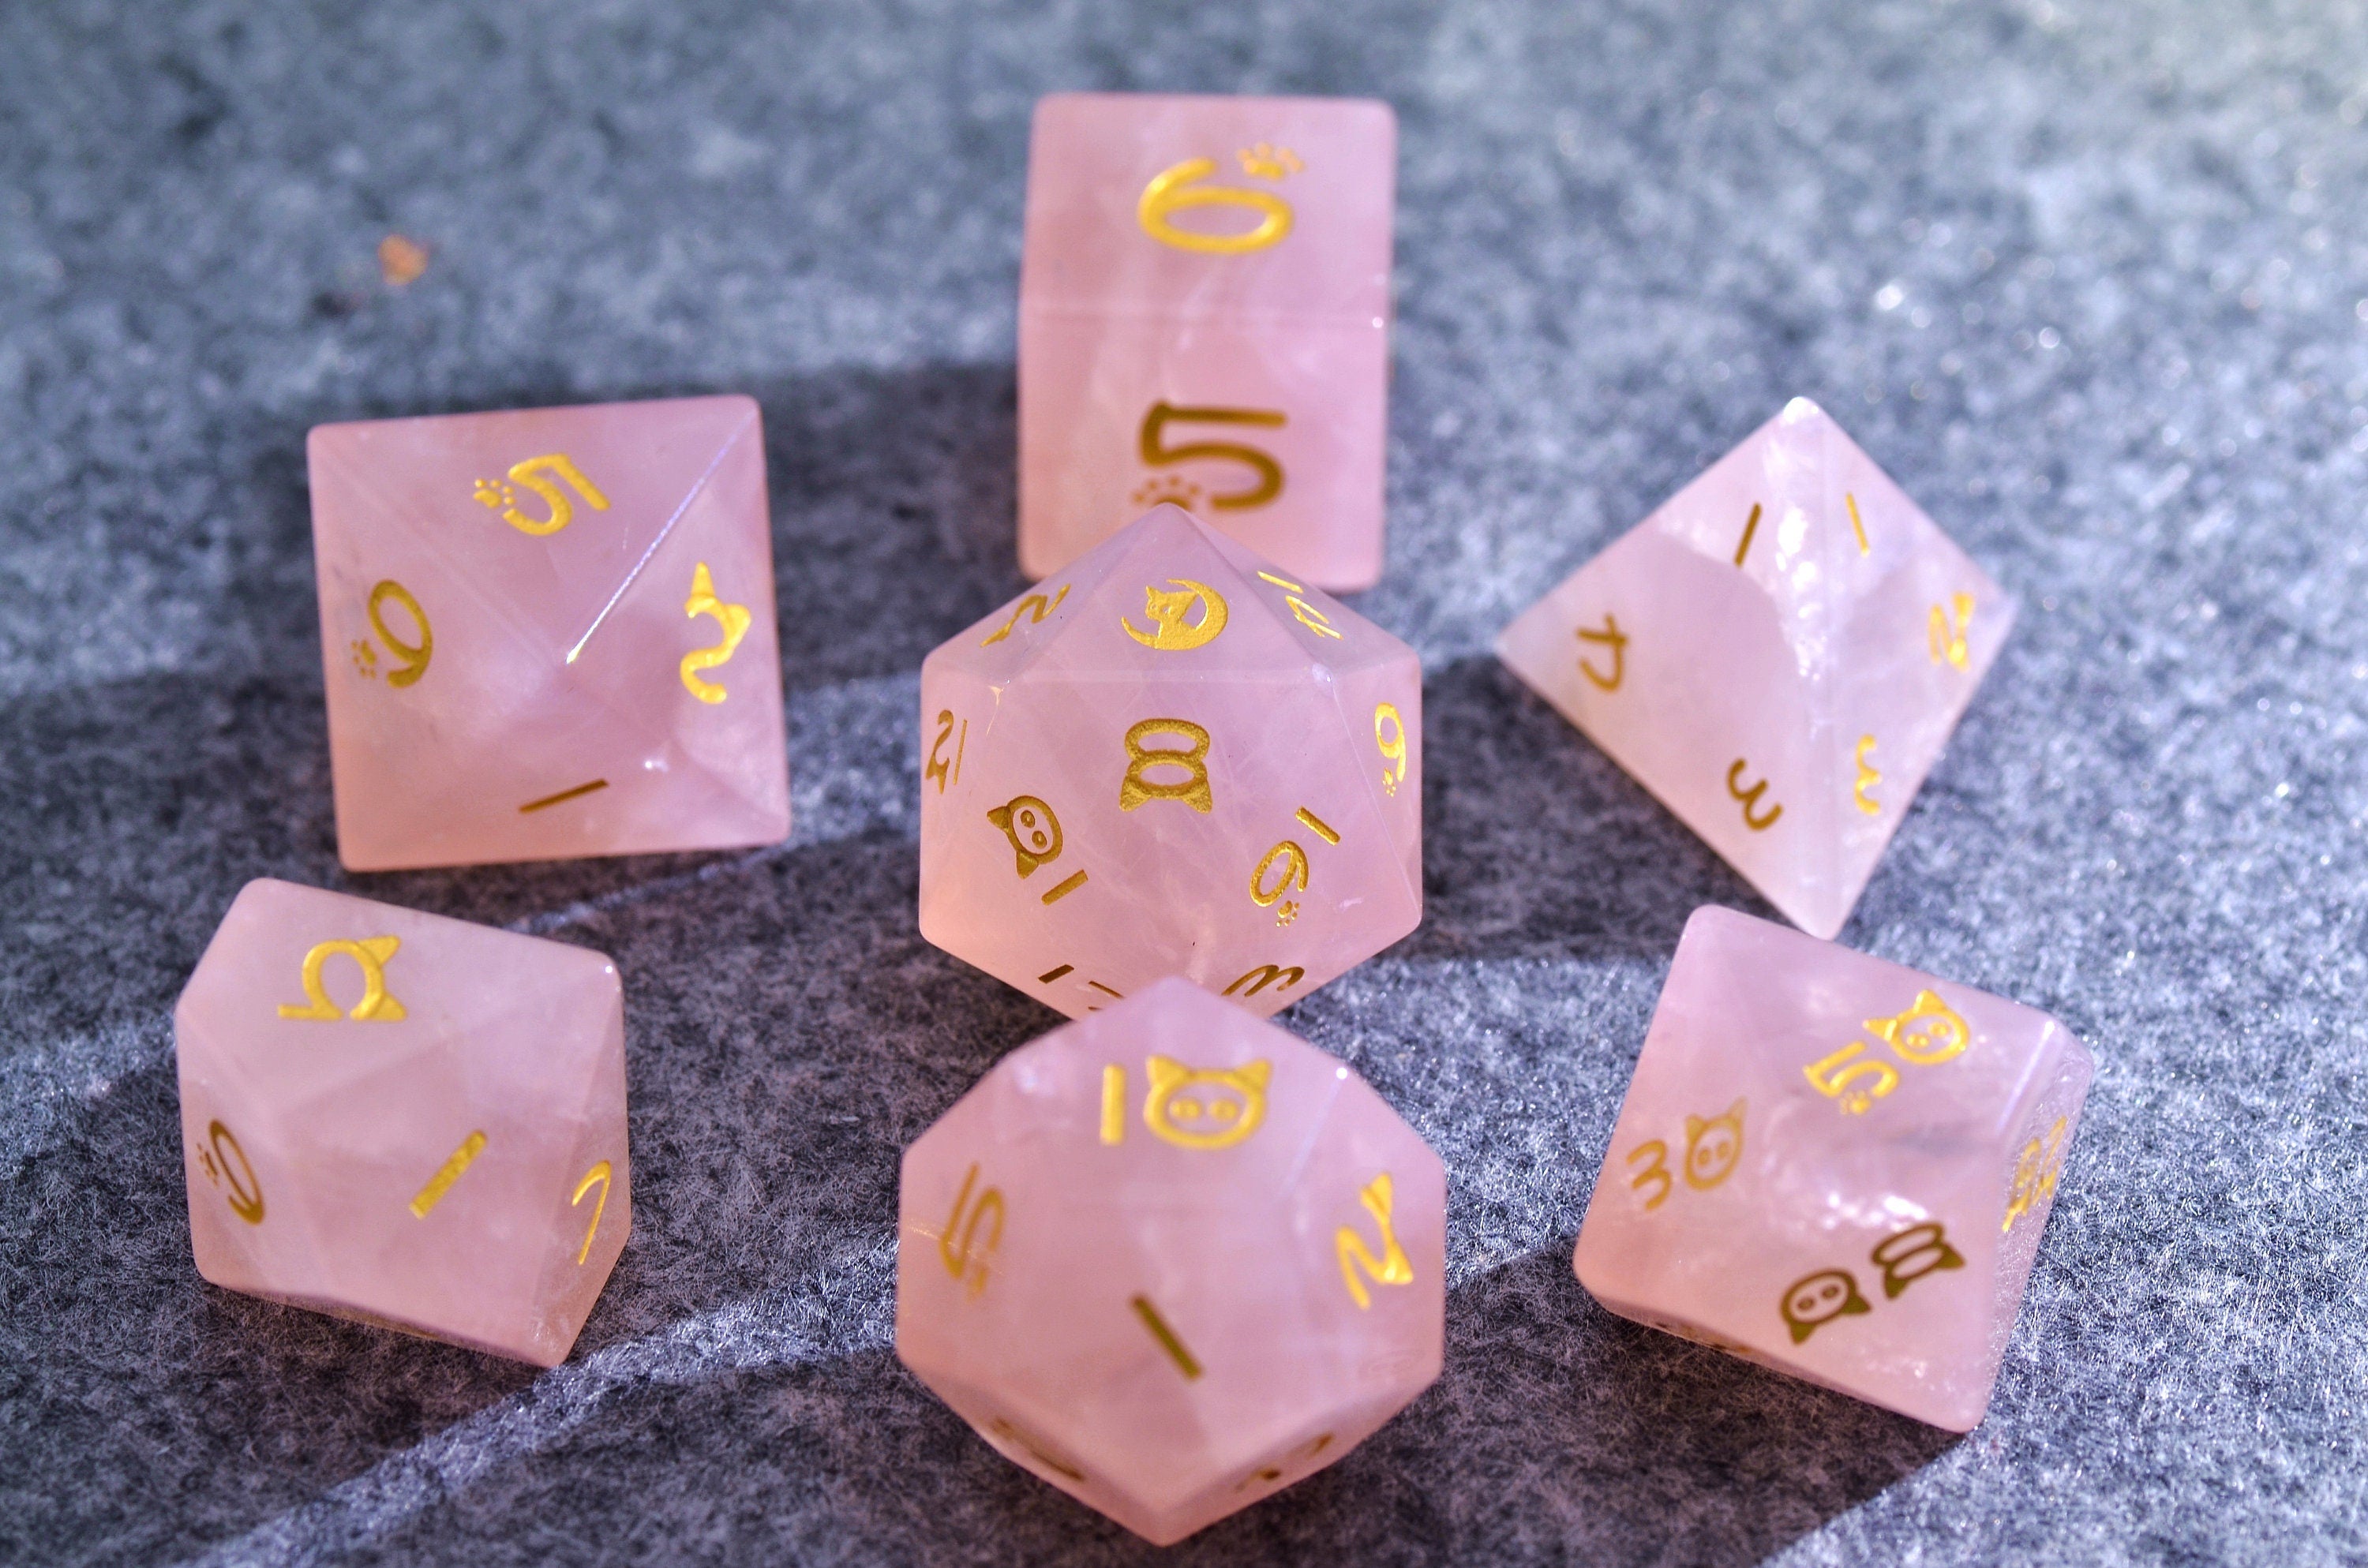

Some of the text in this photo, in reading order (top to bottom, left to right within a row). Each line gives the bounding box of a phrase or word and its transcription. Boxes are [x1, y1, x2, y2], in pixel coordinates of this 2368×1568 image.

[1137, 157, 1295, 254] 6
[503, 454, 612, 536] 5
[1137, 400, 1288, 514] 5
[1734, 502, 1762, 567] 1
[1118, 718, 1212, 814] 8
[1726, 758, 1783, 832] 3
[1853, 734, 1881, 816] 3
[1803, 990, 1969, 1097] 50
[1099, 1054, 1272, 1150] 10
[1626, 1097, 1747, 1211] 30
